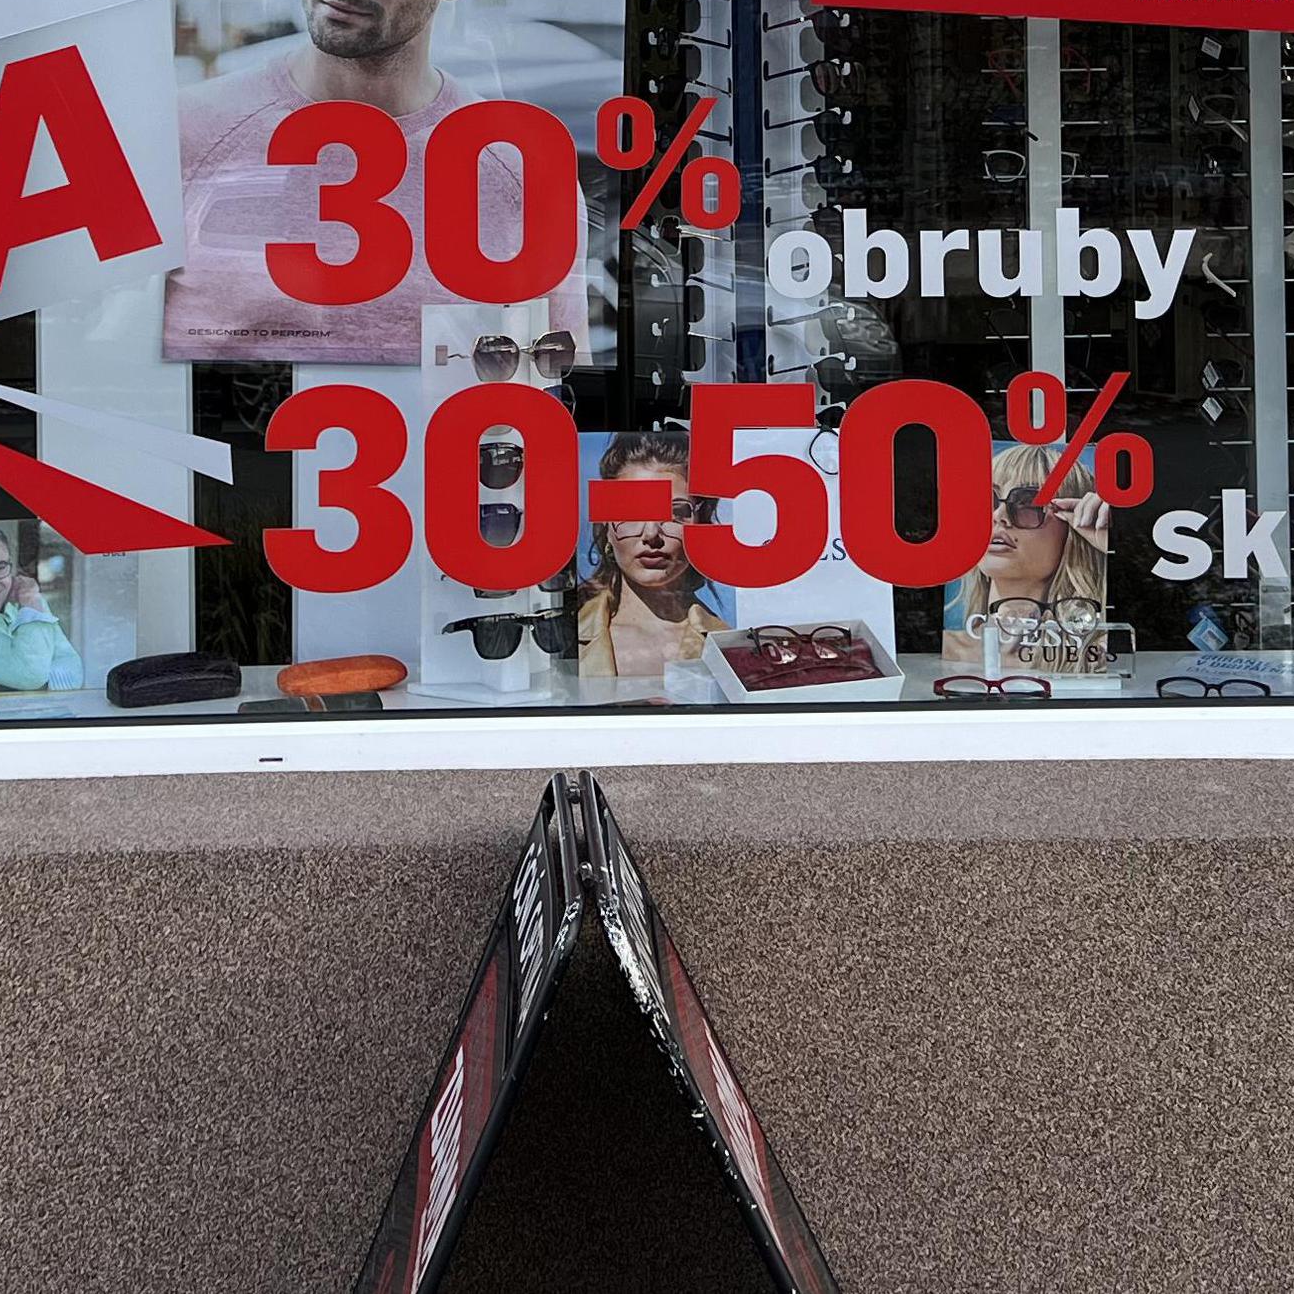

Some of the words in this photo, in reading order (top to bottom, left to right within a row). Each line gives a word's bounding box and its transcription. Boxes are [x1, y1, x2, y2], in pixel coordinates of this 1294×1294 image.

[266, 92, 741, 307] 30%
[767, 208, 1196, 320] obruby
[187, 327, 250, 337] DESIGNED
[252, 328, 269, 337] TO
[271, 329, 331, 338] PERFORM
[1018, 645, 1118, 663] GUESS
